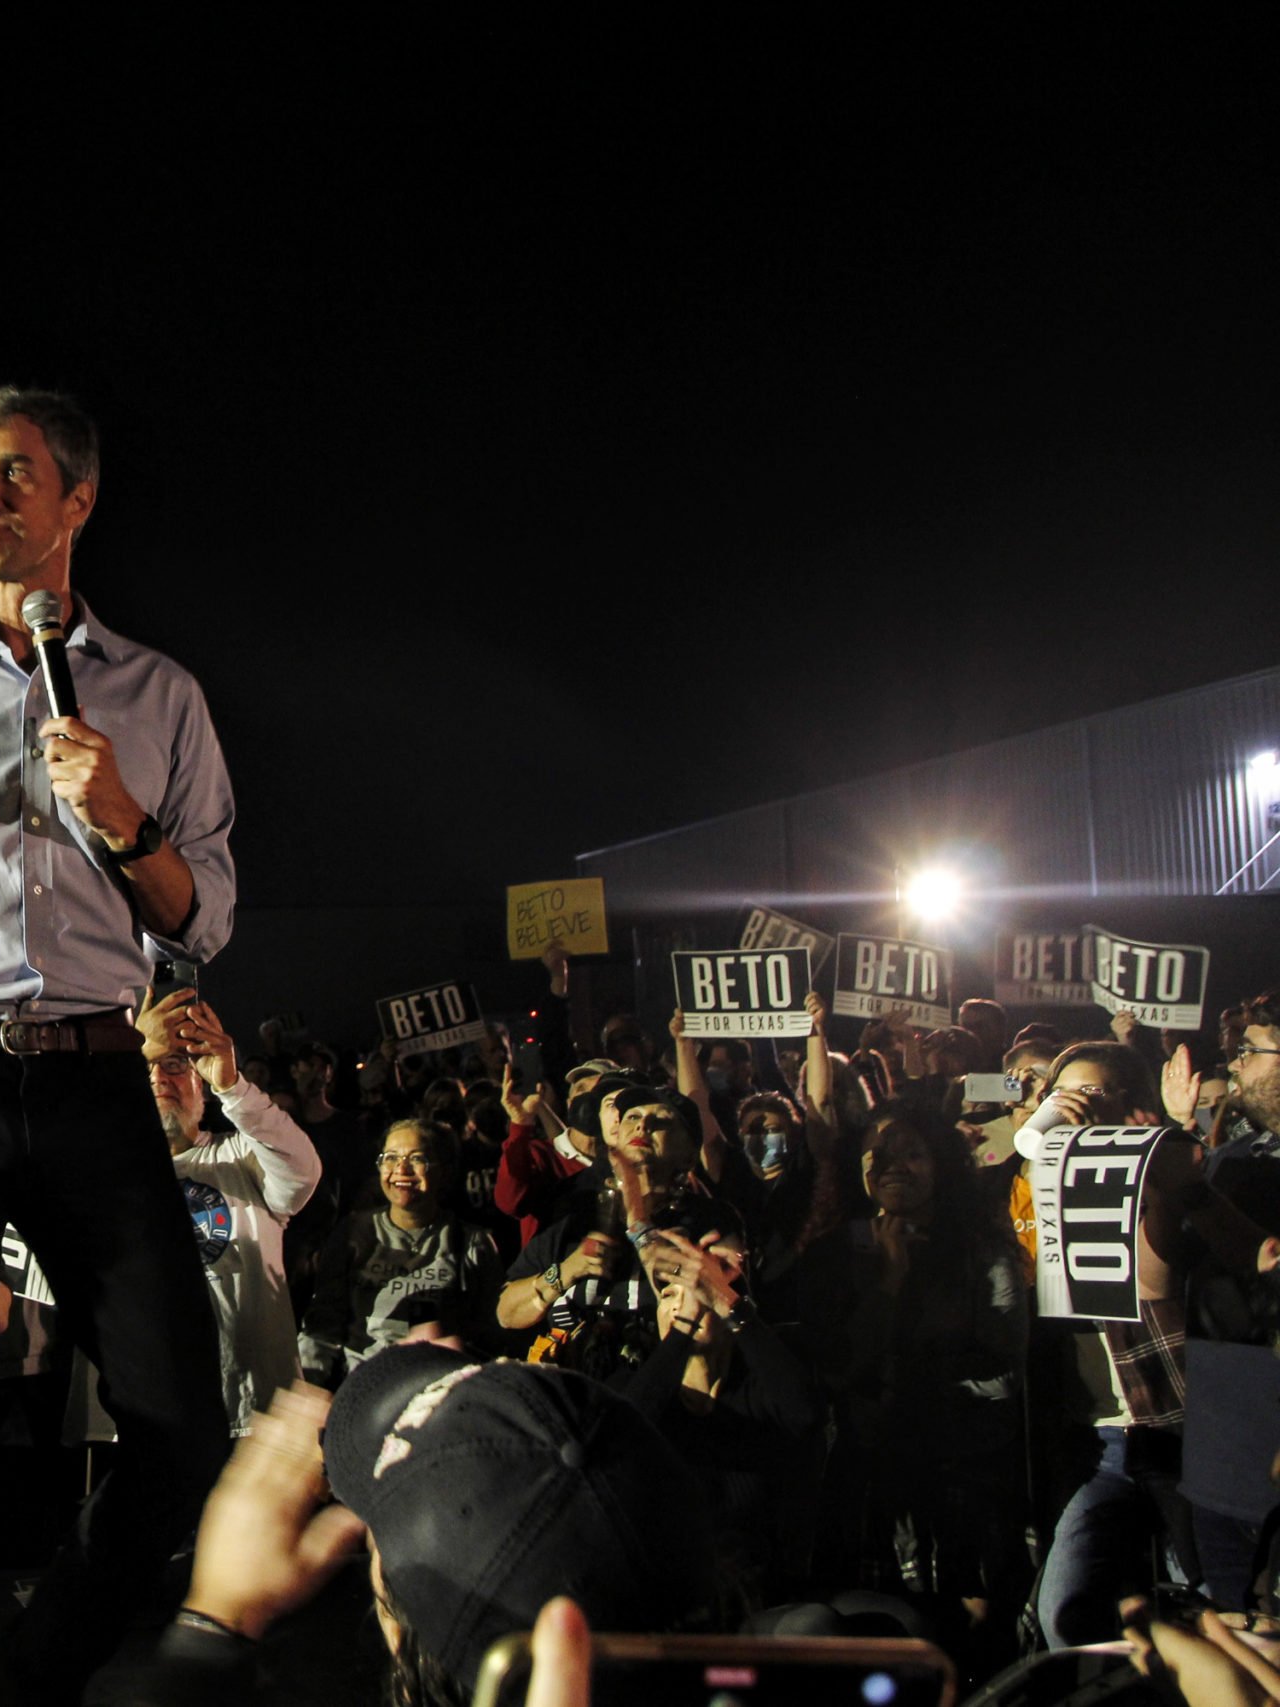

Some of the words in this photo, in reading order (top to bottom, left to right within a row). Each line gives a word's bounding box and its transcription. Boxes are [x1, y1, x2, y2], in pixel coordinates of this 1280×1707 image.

[516, 910, 592, 949] BELIEVE
[517, 887, 565, 922] BETO
[690, 953, 793, 1010] BETO
[854, 940, 938, 1001] BETO
[1096, 934, 1186, 1003] BETO
[389, 984, 467, 1040] BETO
[704, 1016, 731, 1032] FOR
[739, 1014, 786, 1031] TEXAS
[860, 996, 882, 1013] FOR
[1039, 1130, 1073, 1167] FOR
[1038, 1188, 1060, 1263] TEXAS
[1063, 1125, 1163, 1282] BETO
